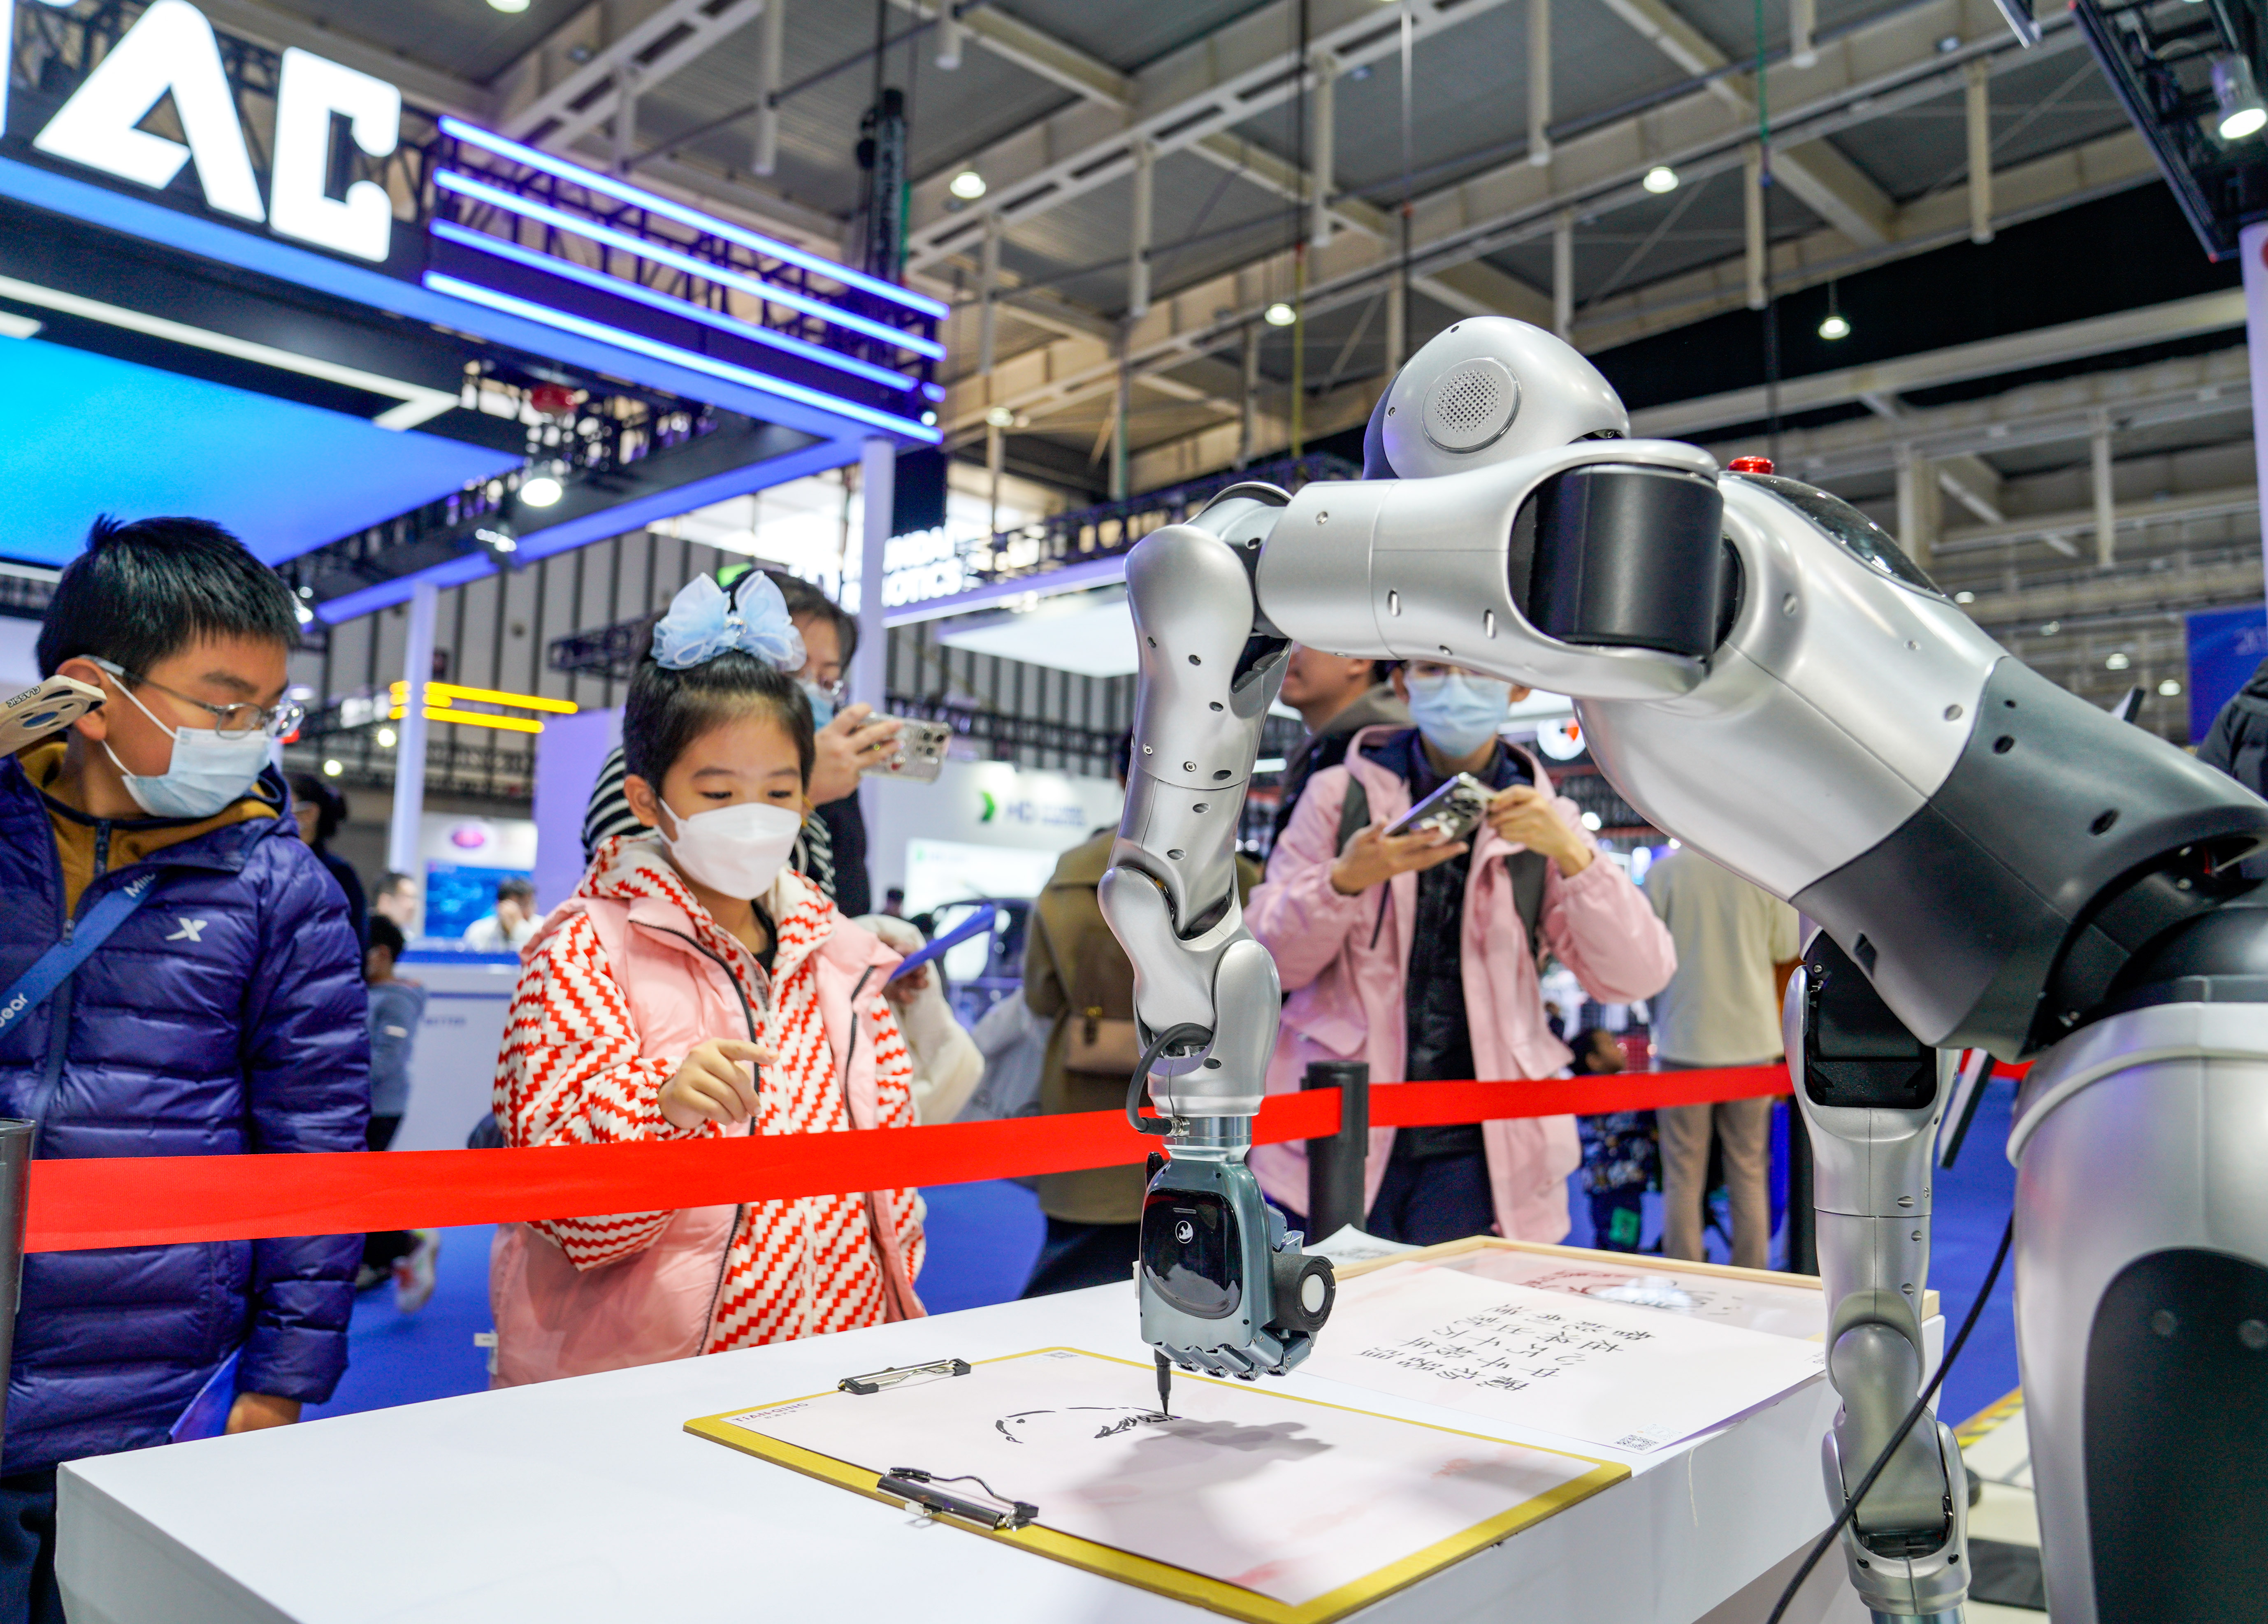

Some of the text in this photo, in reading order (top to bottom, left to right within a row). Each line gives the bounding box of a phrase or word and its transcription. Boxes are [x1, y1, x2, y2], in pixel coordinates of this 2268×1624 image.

[0, 0, 402, 262] AC
[6, 686, 41, 708] CLASSIC
[1476, 1329, 1656, 1392] 智在心中藏
